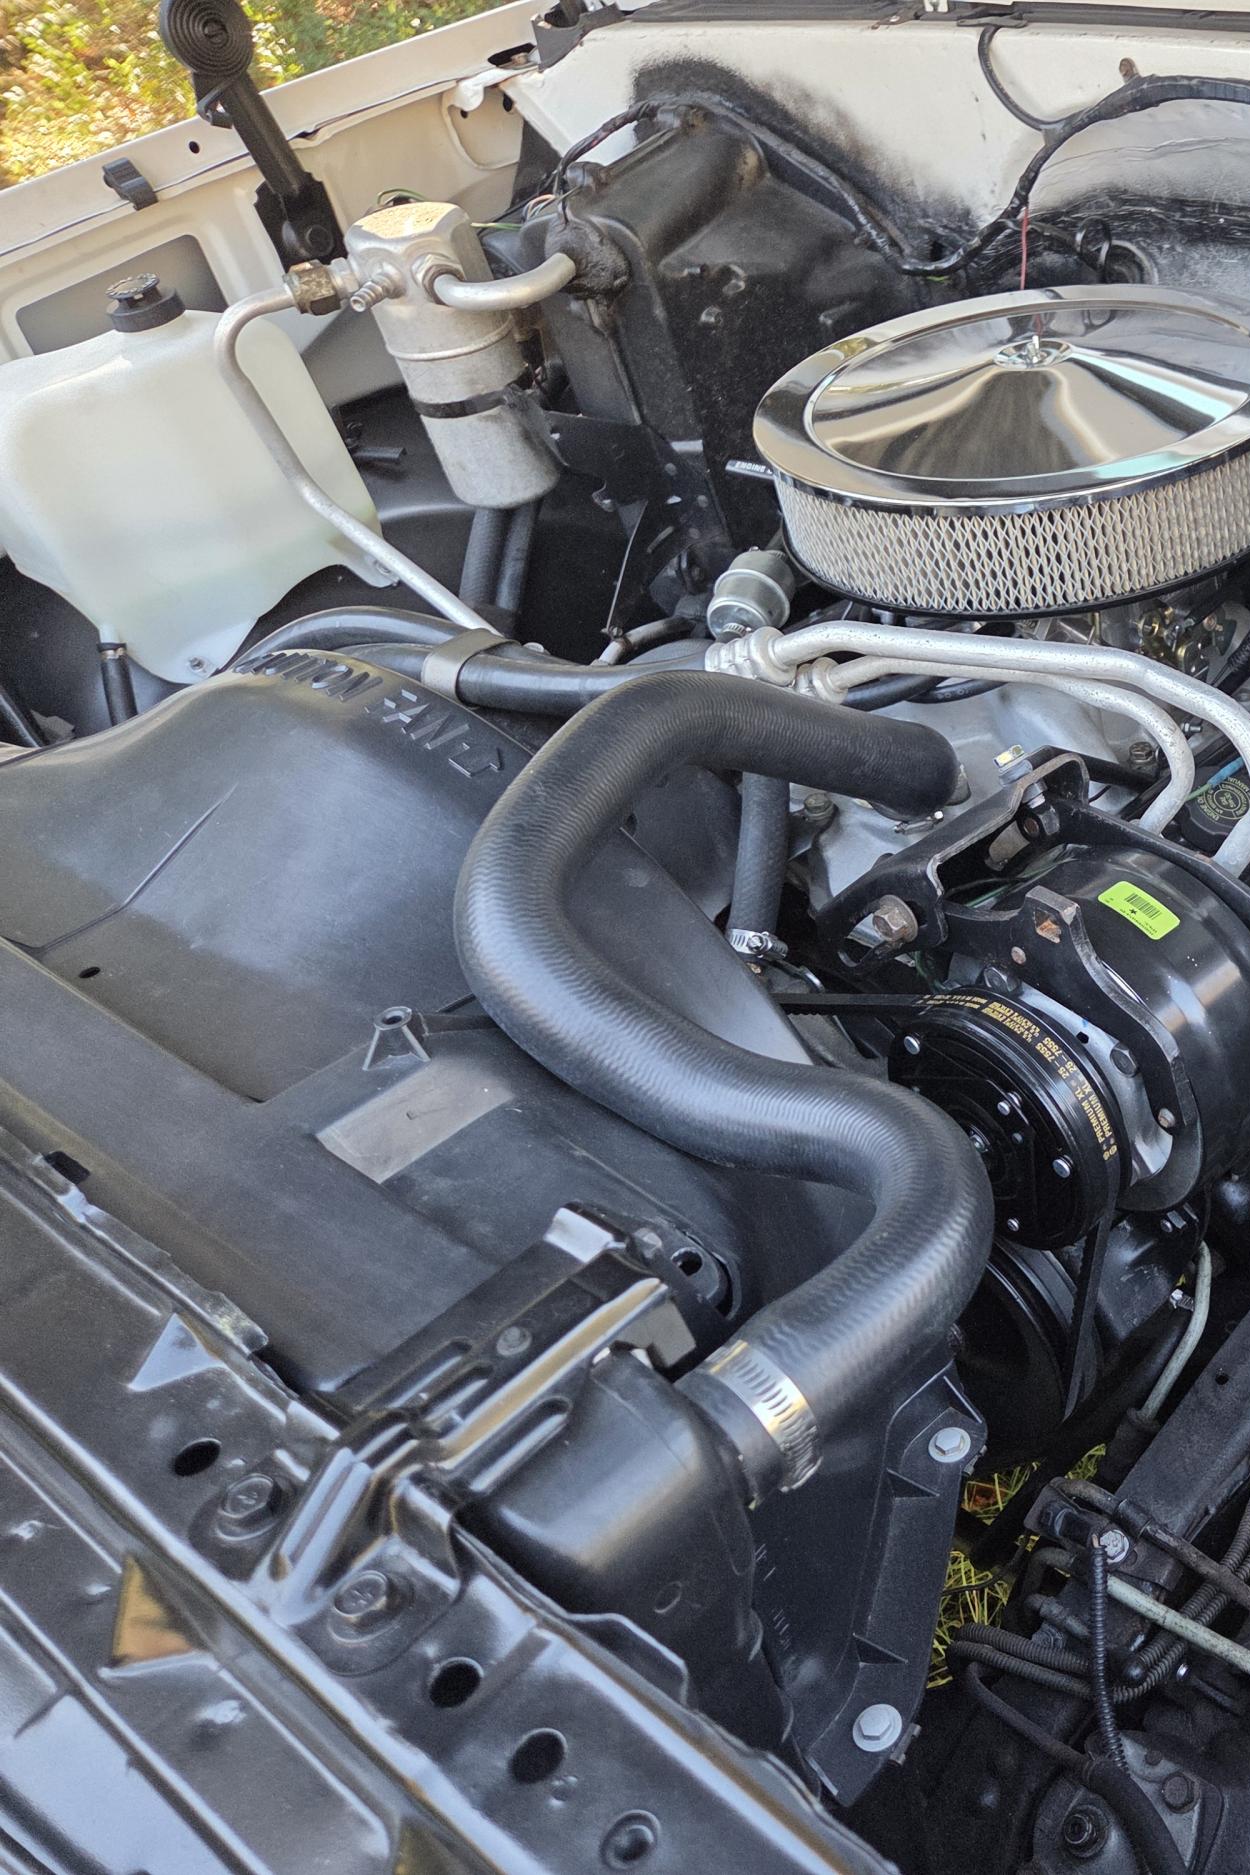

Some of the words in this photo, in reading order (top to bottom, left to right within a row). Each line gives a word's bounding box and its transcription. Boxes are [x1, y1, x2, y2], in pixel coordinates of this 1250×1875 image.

[363, 688, 471, 751] FAN
[1074, 1087, 1085, 1100] XL
[1081, 1079, 1092, 1094] XL
[1081, 1099, 1106, 1144] PREMIUM
[1088, 1093, 1113, 1138] PREMIUM
